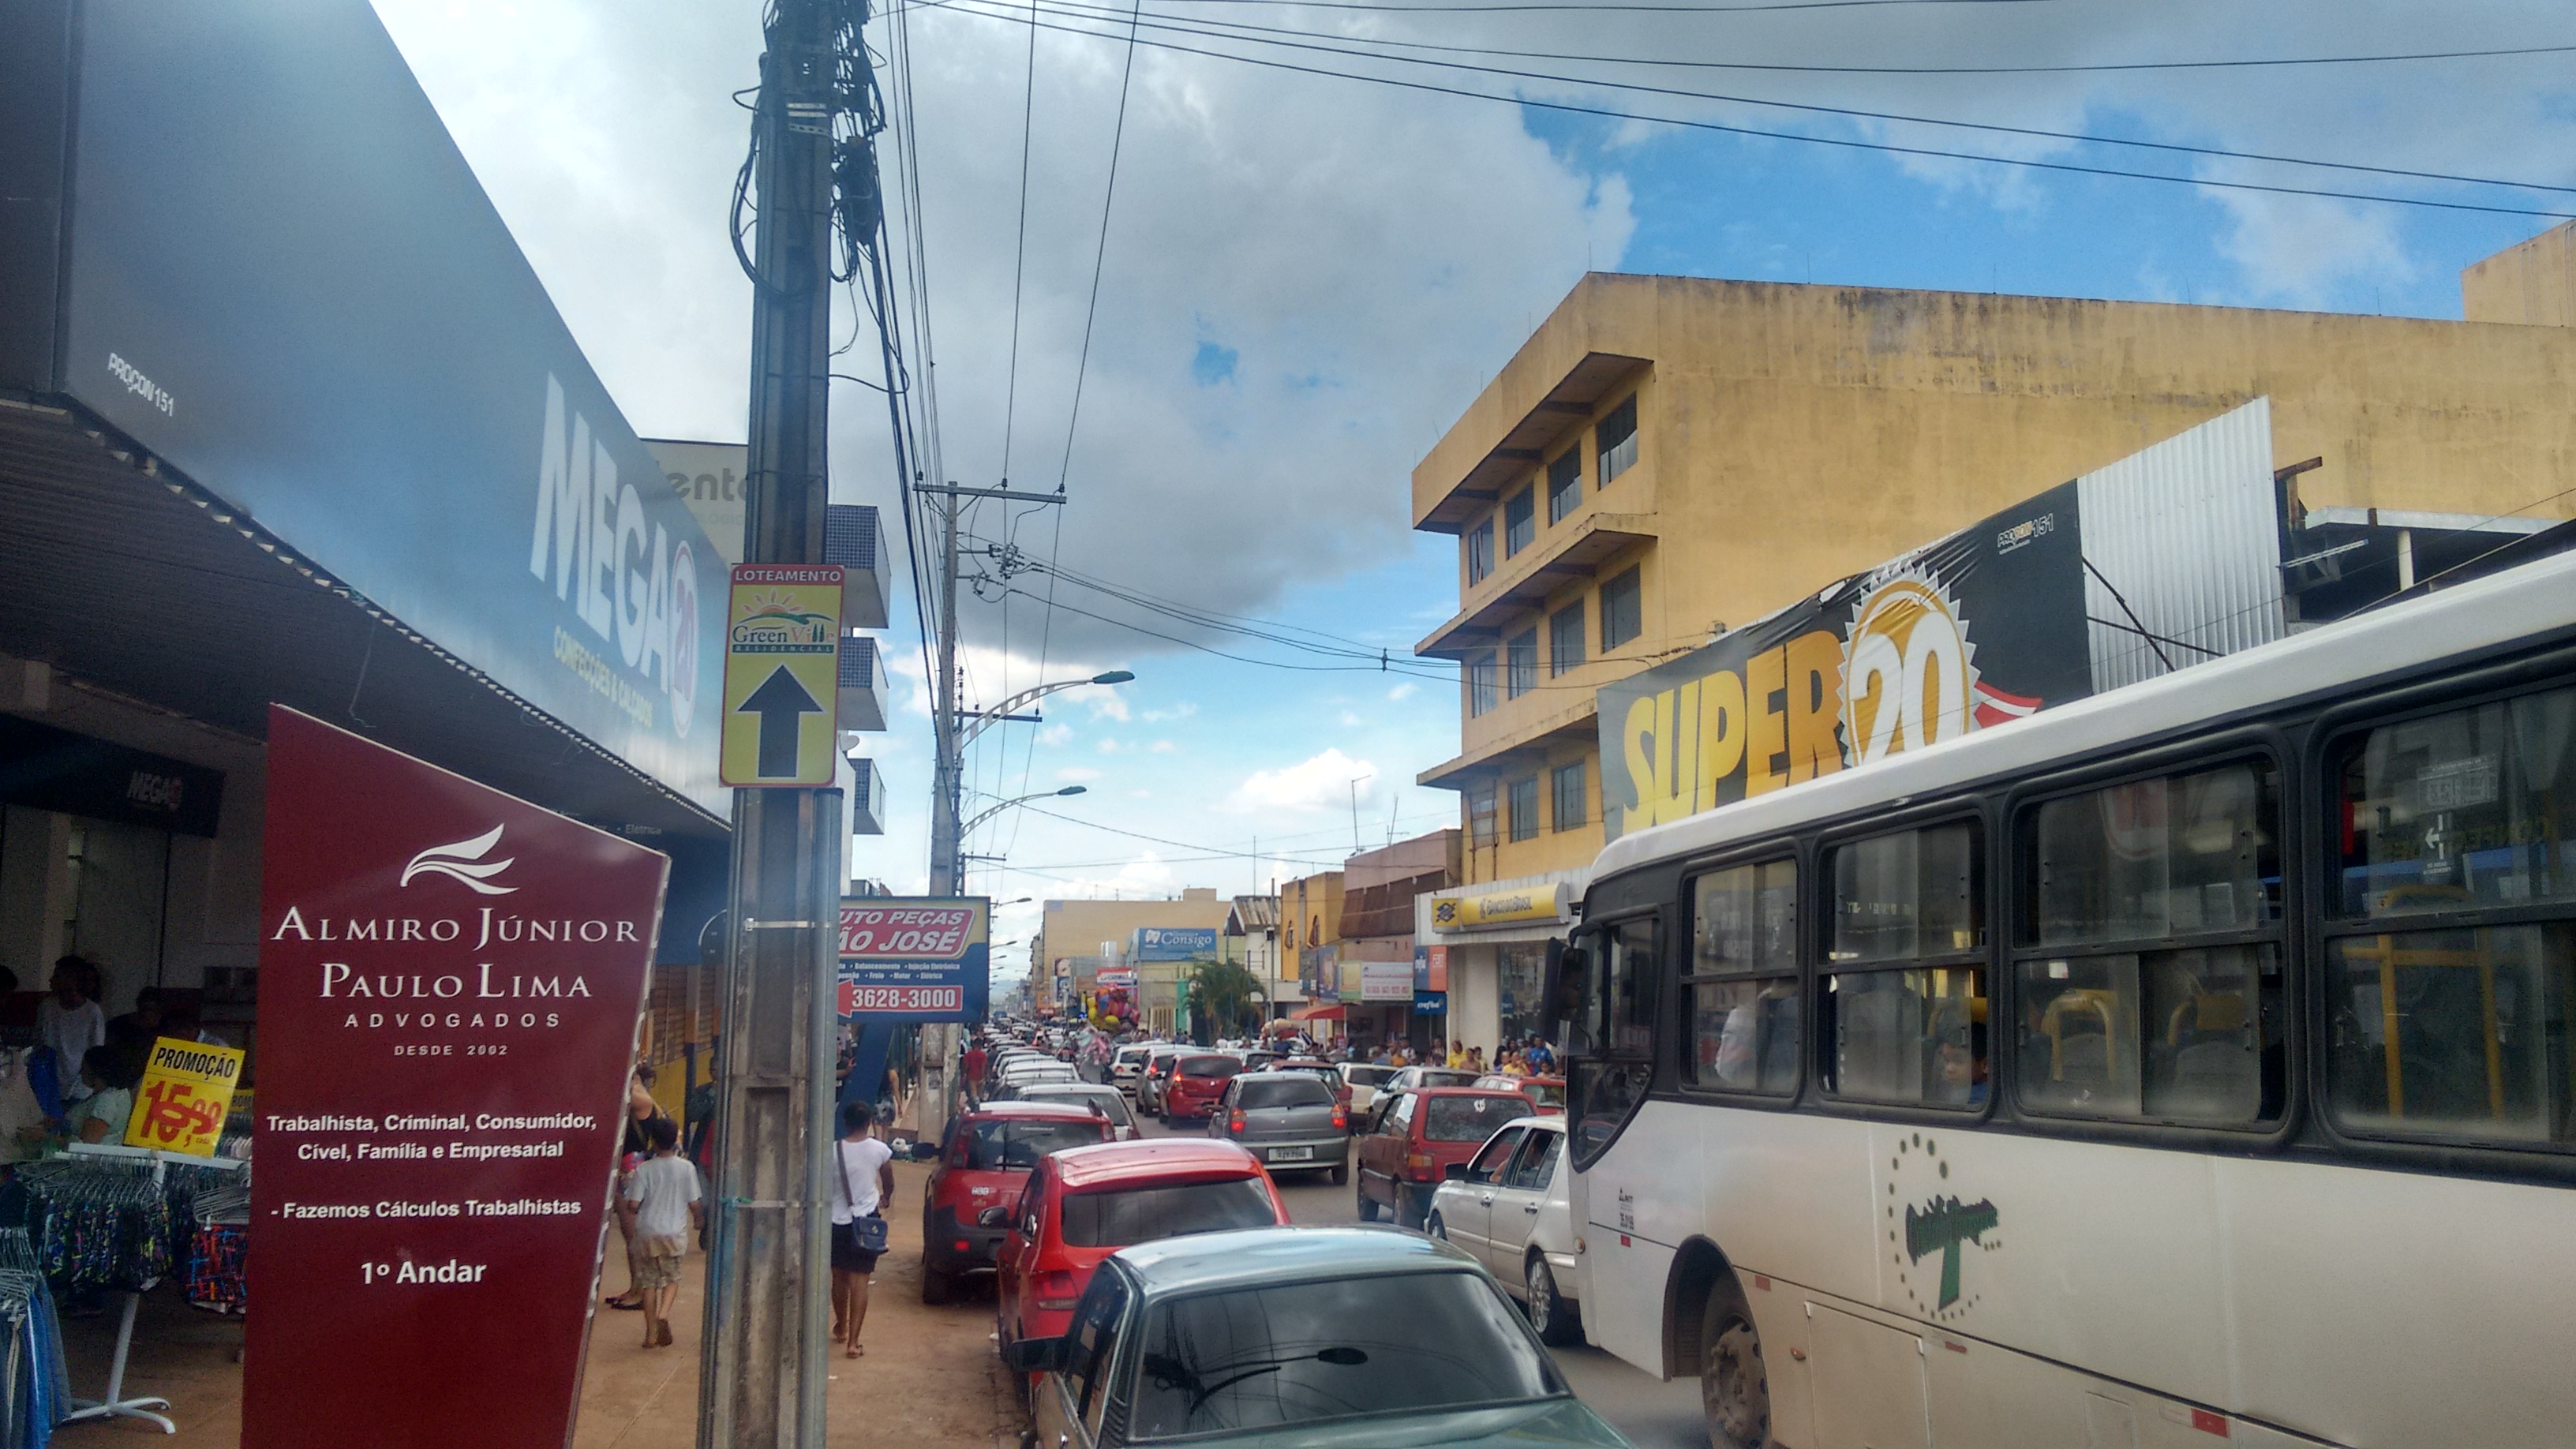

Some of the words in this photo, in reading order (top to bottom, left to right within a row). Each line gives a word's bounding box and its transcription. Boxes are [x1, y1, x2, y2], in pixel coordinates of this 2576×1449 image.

[155, 388, 173, 417] 151
[530, 371, 669, 695] MEGA
[2032, 512, 2054, 537] 151
[735, 570, 841, 582] LOTEAMENTO
[1622, 631, 1845, 833] SUPER
[1848, 610, 1965, 765] 20
[270, 905, 460, 942] ALMIRO
[473, 907, 640, 951] JÚNIOR
[840, 911, 885, 924] UTO
[888, 910, 965, 927] PEÇAS
[839, 926, 874, 952] ÃO
[878, 926, 960, 952] JOSÉ
[1161, 931, 1212, 949] Consigo
[319, 963, 463, 998] PAULO
[476, 963, 593, 998] LIMA
[852, 988, 956, 1008] 3628-3000
[344, 1013, 560, 1028] ADVOGADOS
[395, 1045, 453, 1056] DESDE
[467, 1044, 508, 1056] 2002
[153, 1047, 236, 1080] PROMOÇÃO
[266, 1115, 379, 1133] Trabalhista,
[384, 1114, 470, 1133] Criminal,
[475, 1112, 597, 1132] Consumidor,
[298, 1143, 352, 1163] Cível,
[358, 1142, 427, 1160] Família
[432, 1145, 444, 1159] e
[449, 1140, 564, 1162] Empresarial
[283, 1202, 370, 1219] Fazemos
[376, 1200, 459, 1218] Cálculos
[465, 1198, 582, 1216] Trabalhistas
[395, 1259, 487, 1284] Andar
